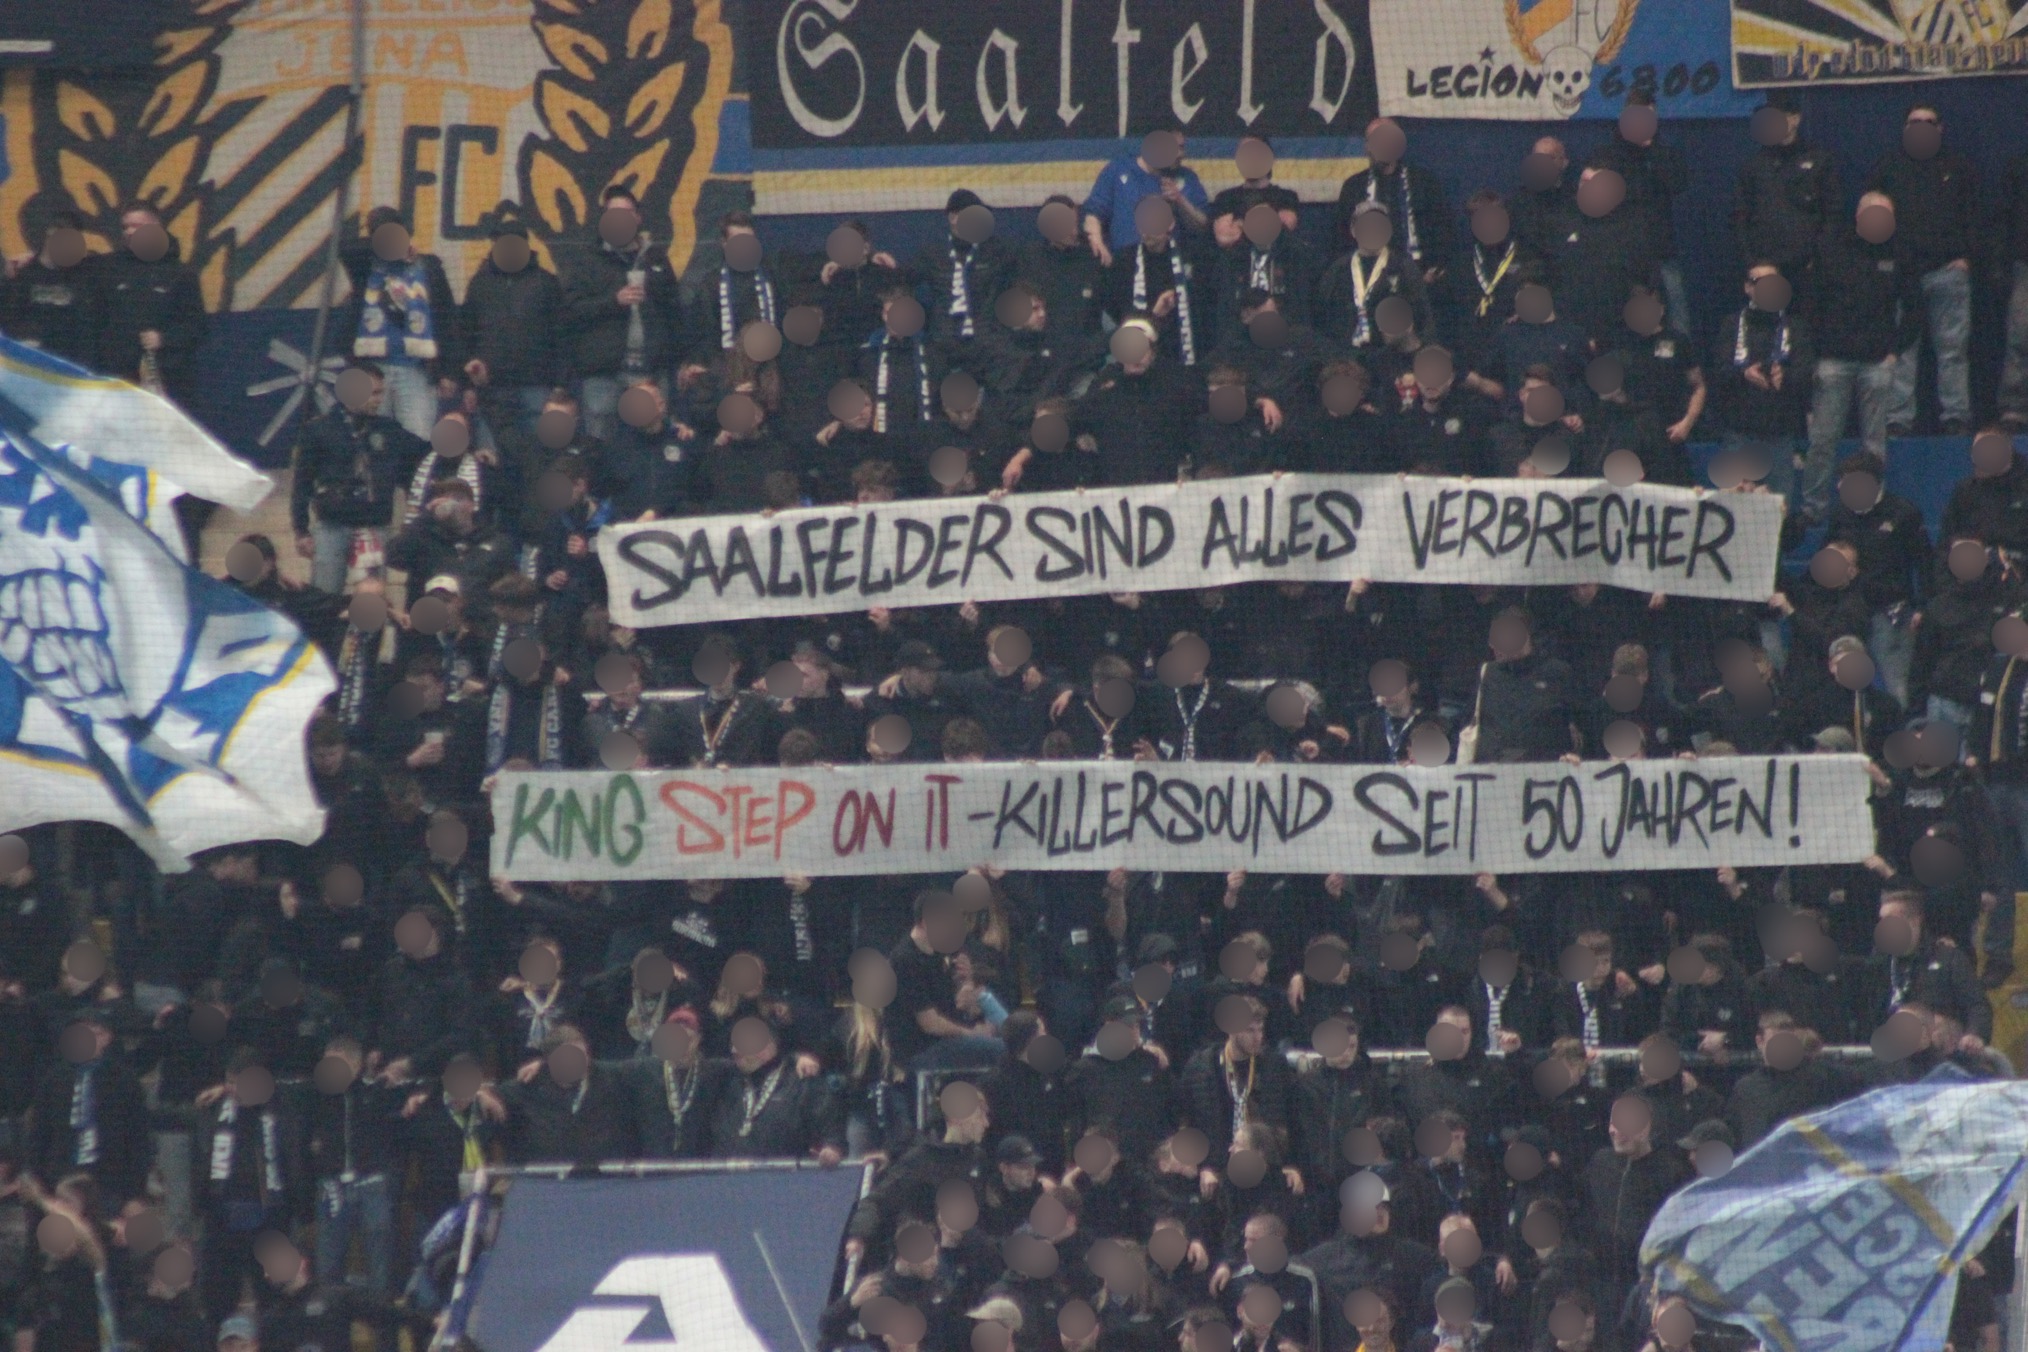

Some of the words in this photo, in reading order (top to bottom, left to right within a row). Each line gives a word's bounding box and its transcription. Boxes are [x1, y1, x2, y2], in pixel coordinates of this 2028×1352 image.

[275, 30, 469, 77] JENA
[1405, 58, 1544, 99] LEGION
[402, 124, 499, 240] FC
[617, 502, 1014, 612] SAALFELDER
[1025, 497, 1175, 583] SIND
[1201, 486, 1362, 569] ALLES
[1403, 488, 1736, 583] VERBRECHER
[505, 773, 647, 869] KING
[659, 779, 816, 860] STEP
[832, 786, 896, 857] ON
[925, 774, 963, 852] IT
[1353, 772, 1496, 862] SEIT
[1522, 775, 1585, 860] 50
